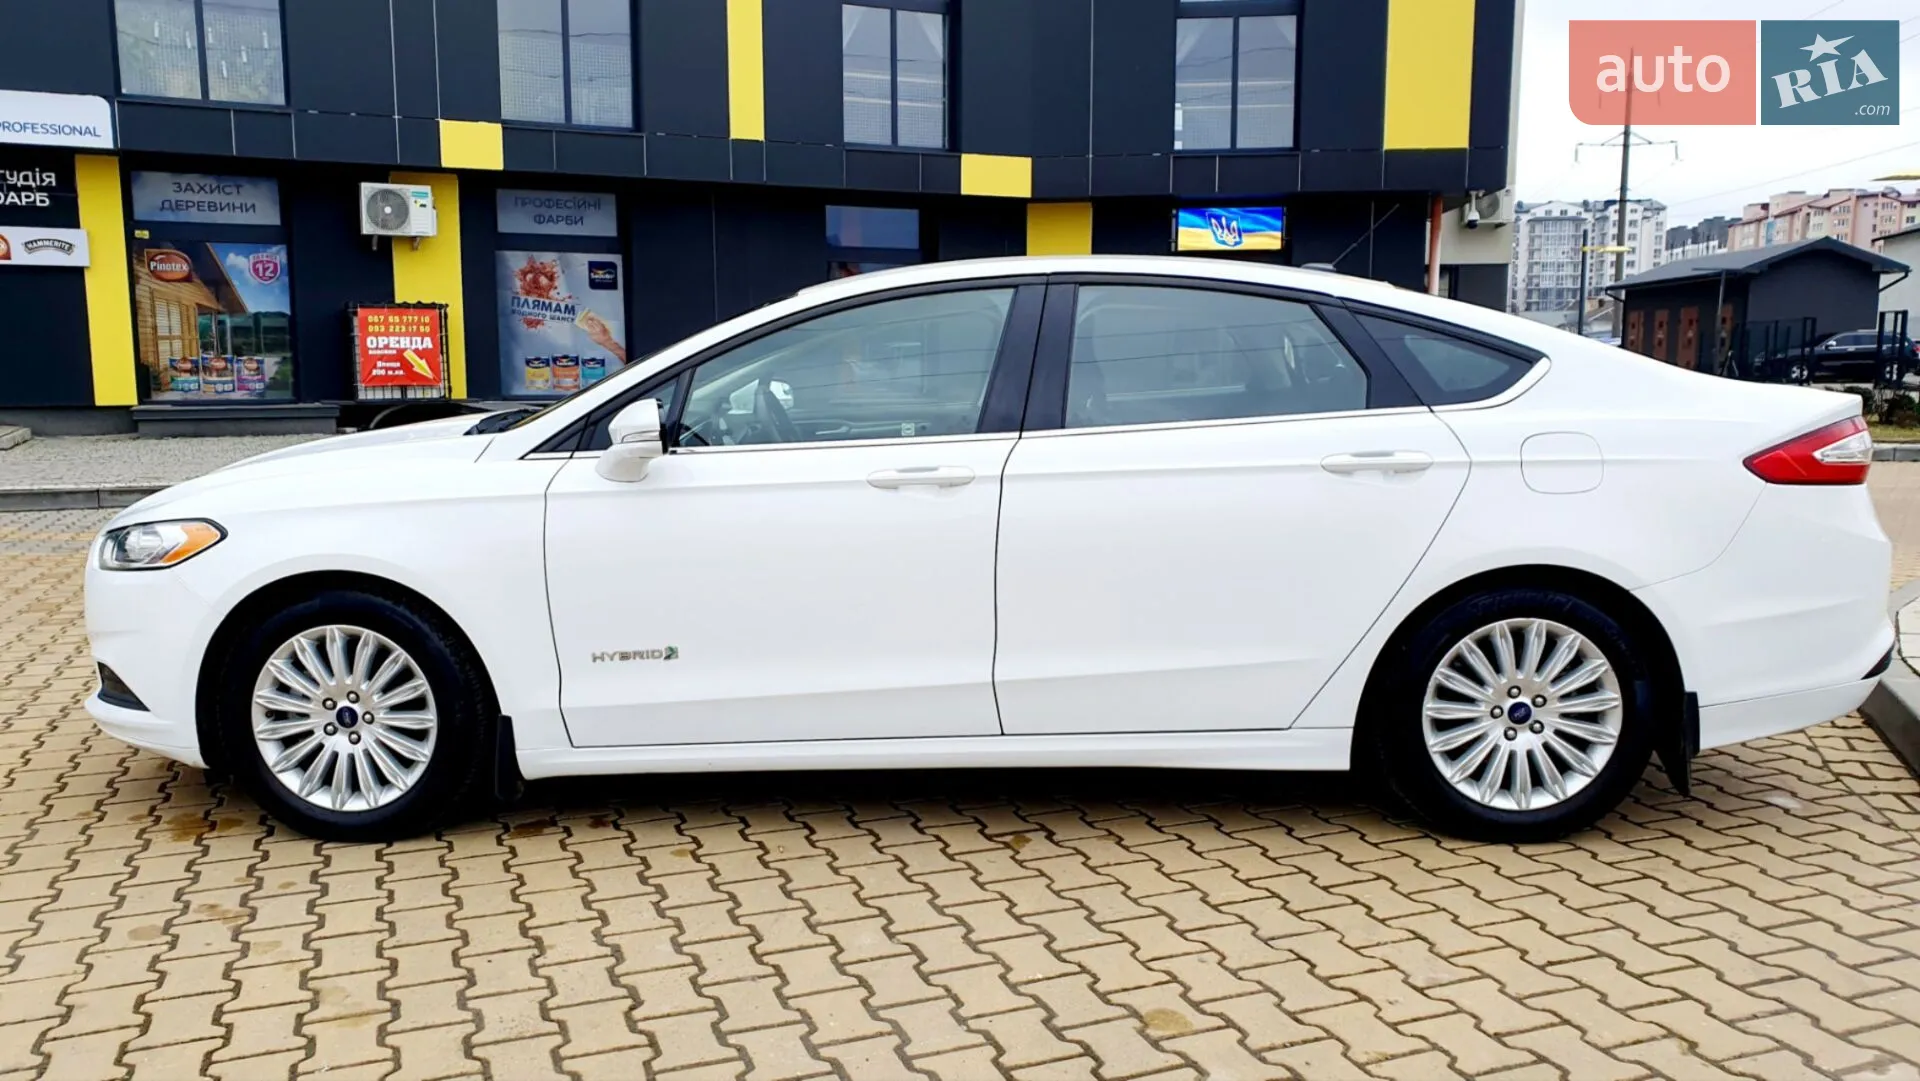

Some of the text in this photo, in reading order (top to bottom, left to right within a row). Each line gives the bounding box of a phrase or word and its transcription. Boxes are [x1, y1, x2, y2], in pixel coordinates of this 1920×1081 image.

[172, 182, 243, 196] ЗАХИСТ
[159, 199, 256, 214] ДЕРЕВИНИ
[514, 196, 600, 211] ПРОФЕСІЙНІ
[533, 214, 584, 226] ФАРБИ
[150, 260, 189, 272] Pinotex
[256, 263, 274, 277] 12
[511, 296, 575, 316] ПЛЯМАМ
[366, 336, 433, 350] ОРЕНДА
[591, 649, 663, 662] HYBRID
